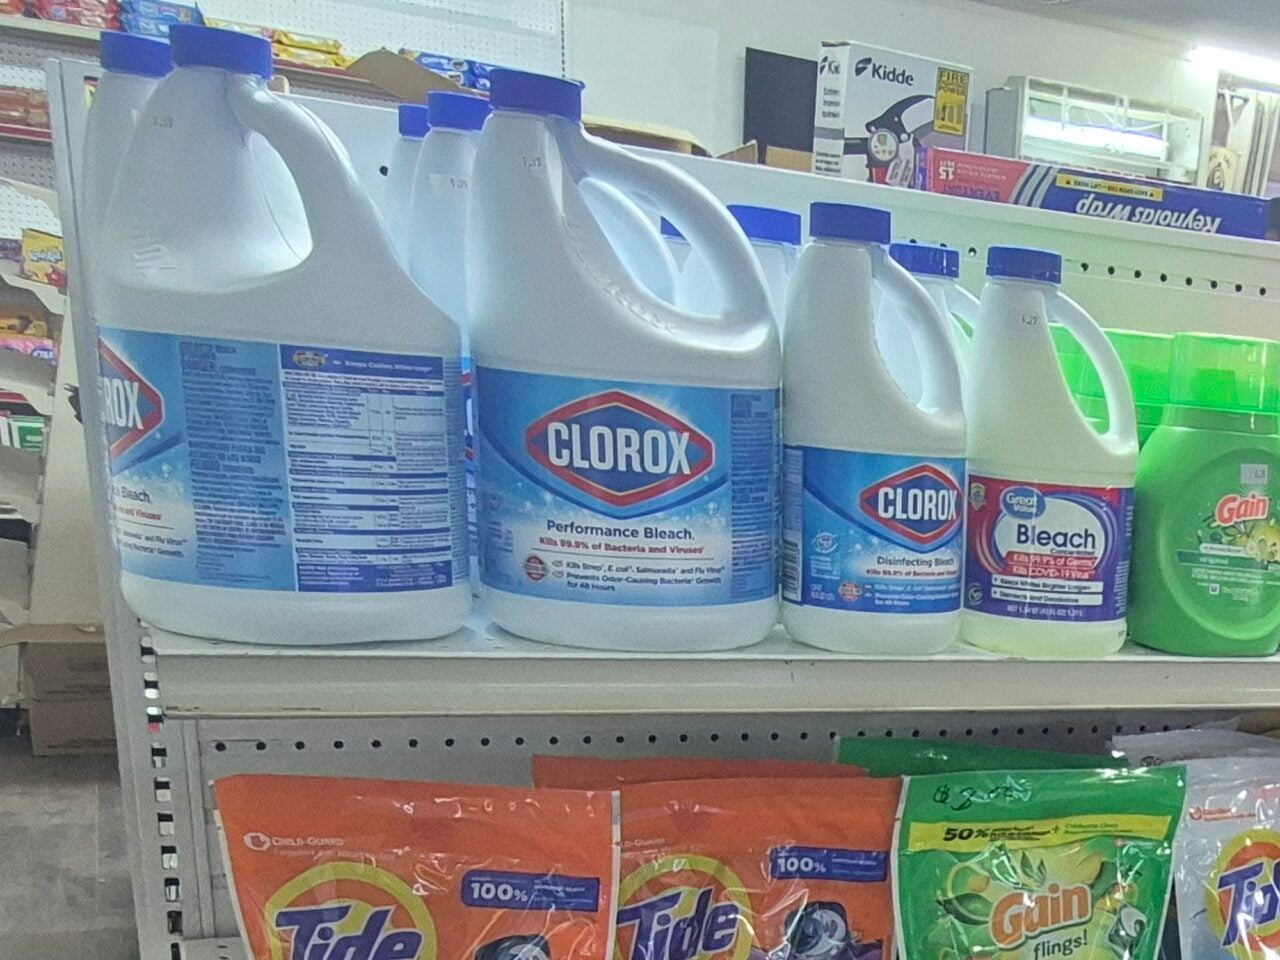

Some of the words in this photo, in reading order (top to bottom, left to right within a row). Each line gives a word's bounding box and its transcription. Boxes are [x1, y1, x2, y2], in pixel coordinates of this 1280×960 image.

[872, 63, 914, 85] Kidde
[940, 70, 967, 85] FIRE
[1076, 195, 1129, 217] Wrap
[1133, 206, 1221, 234] Reynolds
[102, 376, 143, 429] ROX
[548, 422, 692, 474] CLOROX
[877, 486, 959, 521] CLOROX
[1006, 492, 1038, 507] Great
[1215, 494, 1269, 527] Gain
[547, 520, 639, 539] Performance
[1017, 524, 1096, 549] Bleach
[877, 556, 933, 567] Disinfecting
[1029, 566, 1070, 577] COVID-19
[943, 826, 990, 842] 50%
[776, 856, 826, 873] 100%
[469, 881, 528, 902] 100%
[990, 882, 1091, 951] Gain
